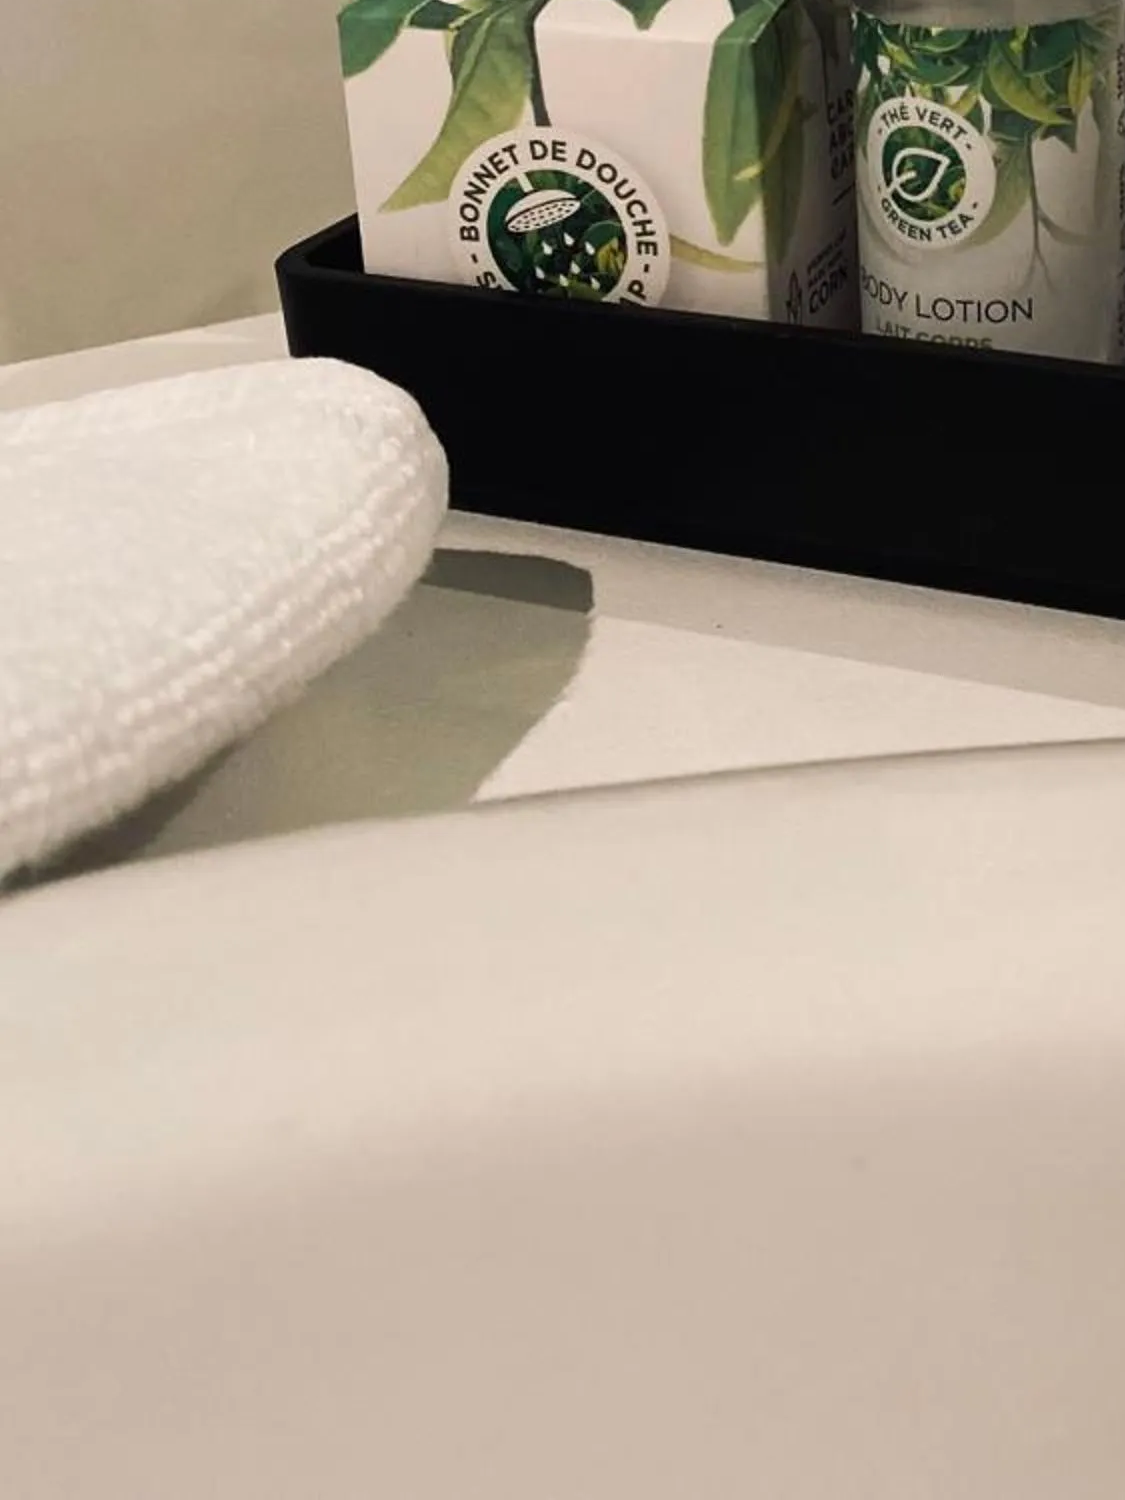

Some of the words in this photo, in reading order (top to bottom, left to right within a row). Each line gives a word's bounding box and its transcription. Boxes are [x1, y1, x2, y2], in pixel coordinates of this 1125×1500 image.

[880, 102, 910, 129] THÉ
[916, 106, 968, 140] VERT
[460, 143, 520, 242] BONNET
[529, 139, 568, 162] DE
[575, 148, 658, 257] DOUCHE
[880, 197, 932, 242] GREEN
[936, 213, 974, 239] TEA
[915, 294, 1033, 323] LOTION
